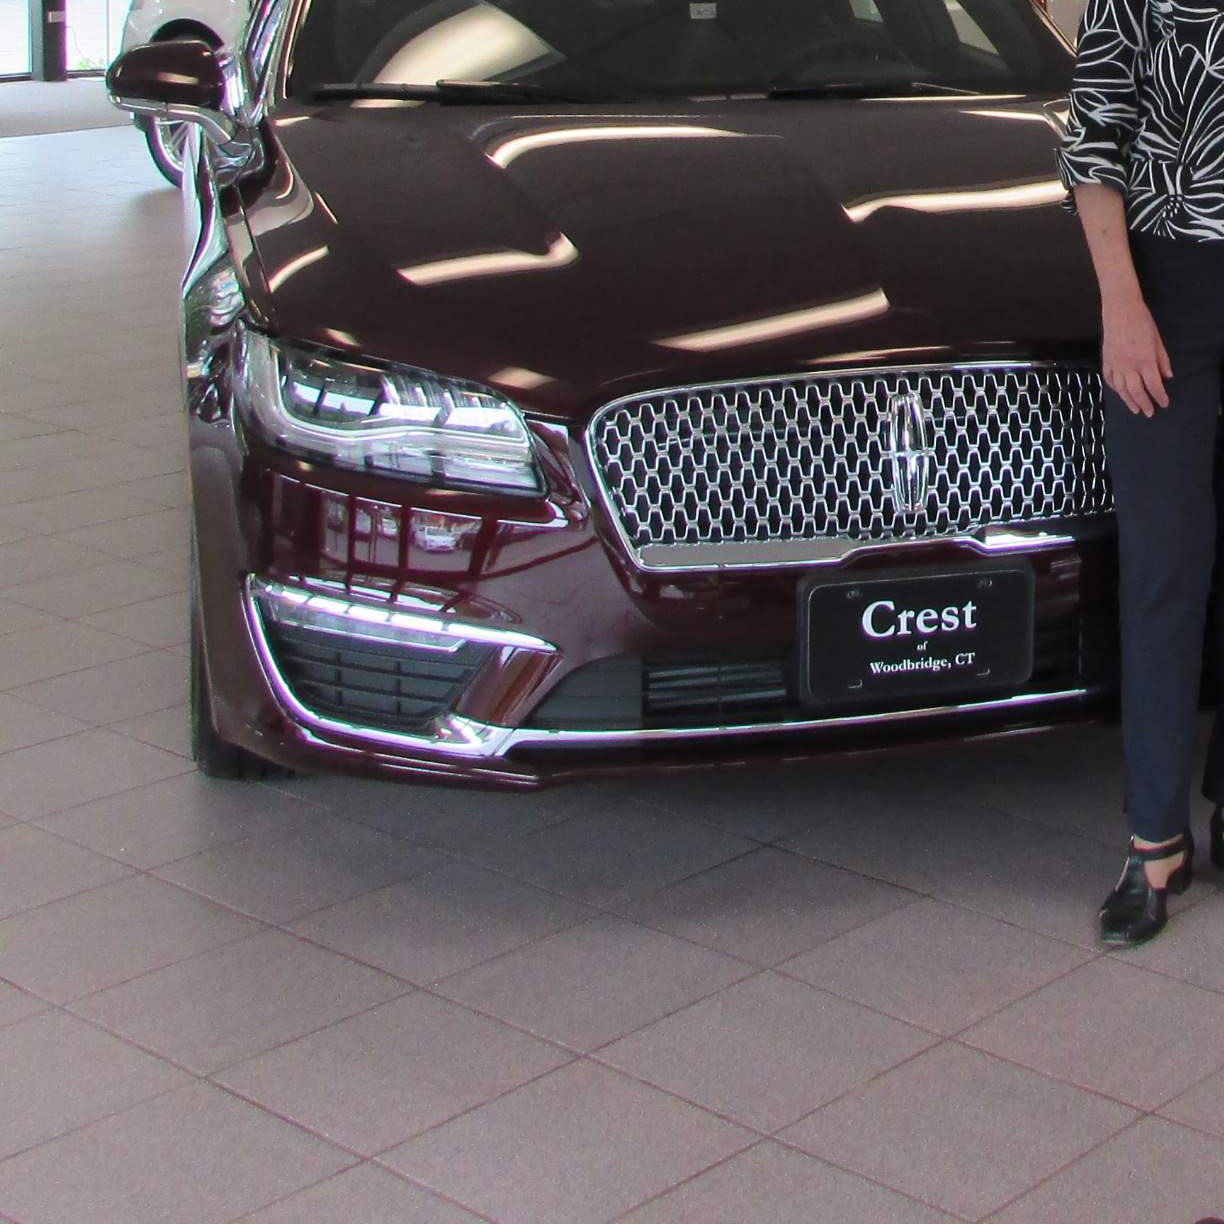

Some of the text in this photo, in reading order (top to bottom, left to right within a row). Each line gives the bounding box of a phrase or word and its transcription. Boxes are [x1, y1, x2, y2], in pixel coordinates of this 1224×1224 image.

[861, 600, 977, 638] Crest
[916, 640, 929, 651] of
[869, 652, 976, 675] Woodbridge, CT
